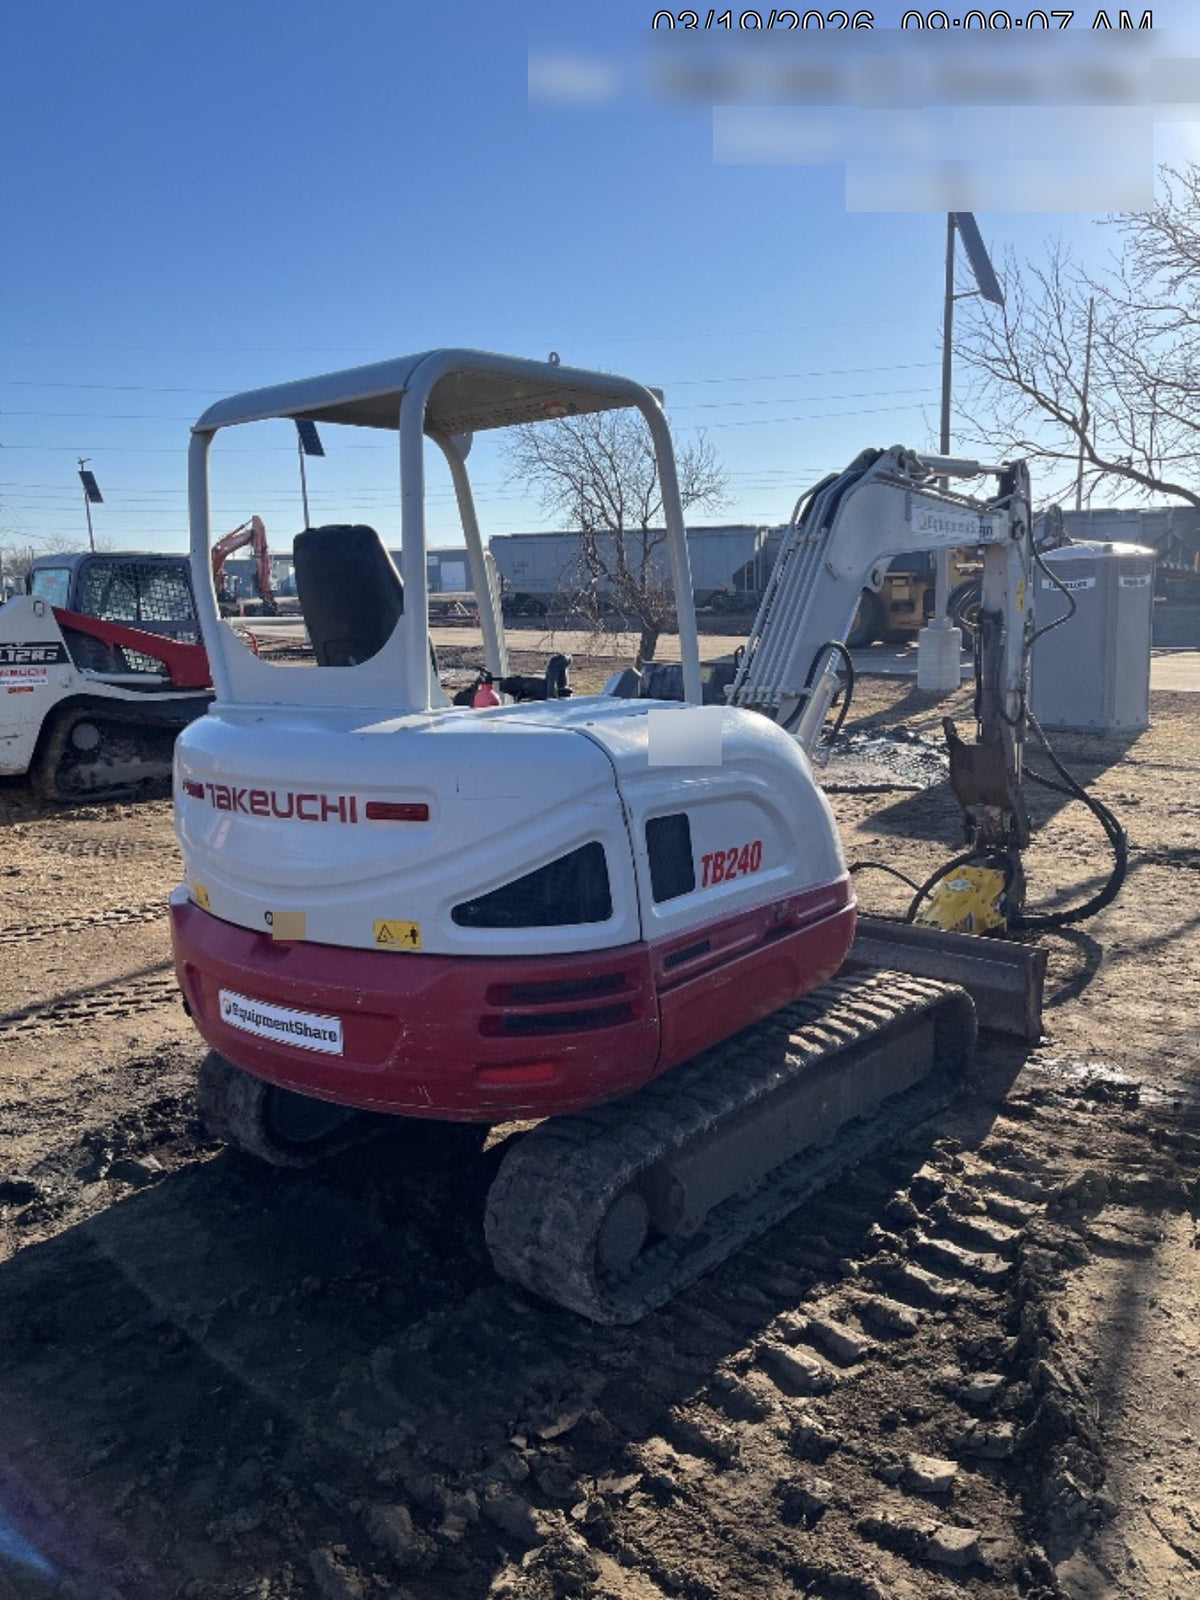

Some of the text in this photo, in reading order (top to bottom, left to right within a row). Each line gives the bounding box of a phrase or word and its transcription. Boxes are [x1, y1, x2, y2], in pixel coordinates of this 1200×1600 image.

[205, 782, 358, 824] TAKEUCHI
[701, 840, 762, 887] TB240
[232, 1002, 338, 1042] EquipmentShare
